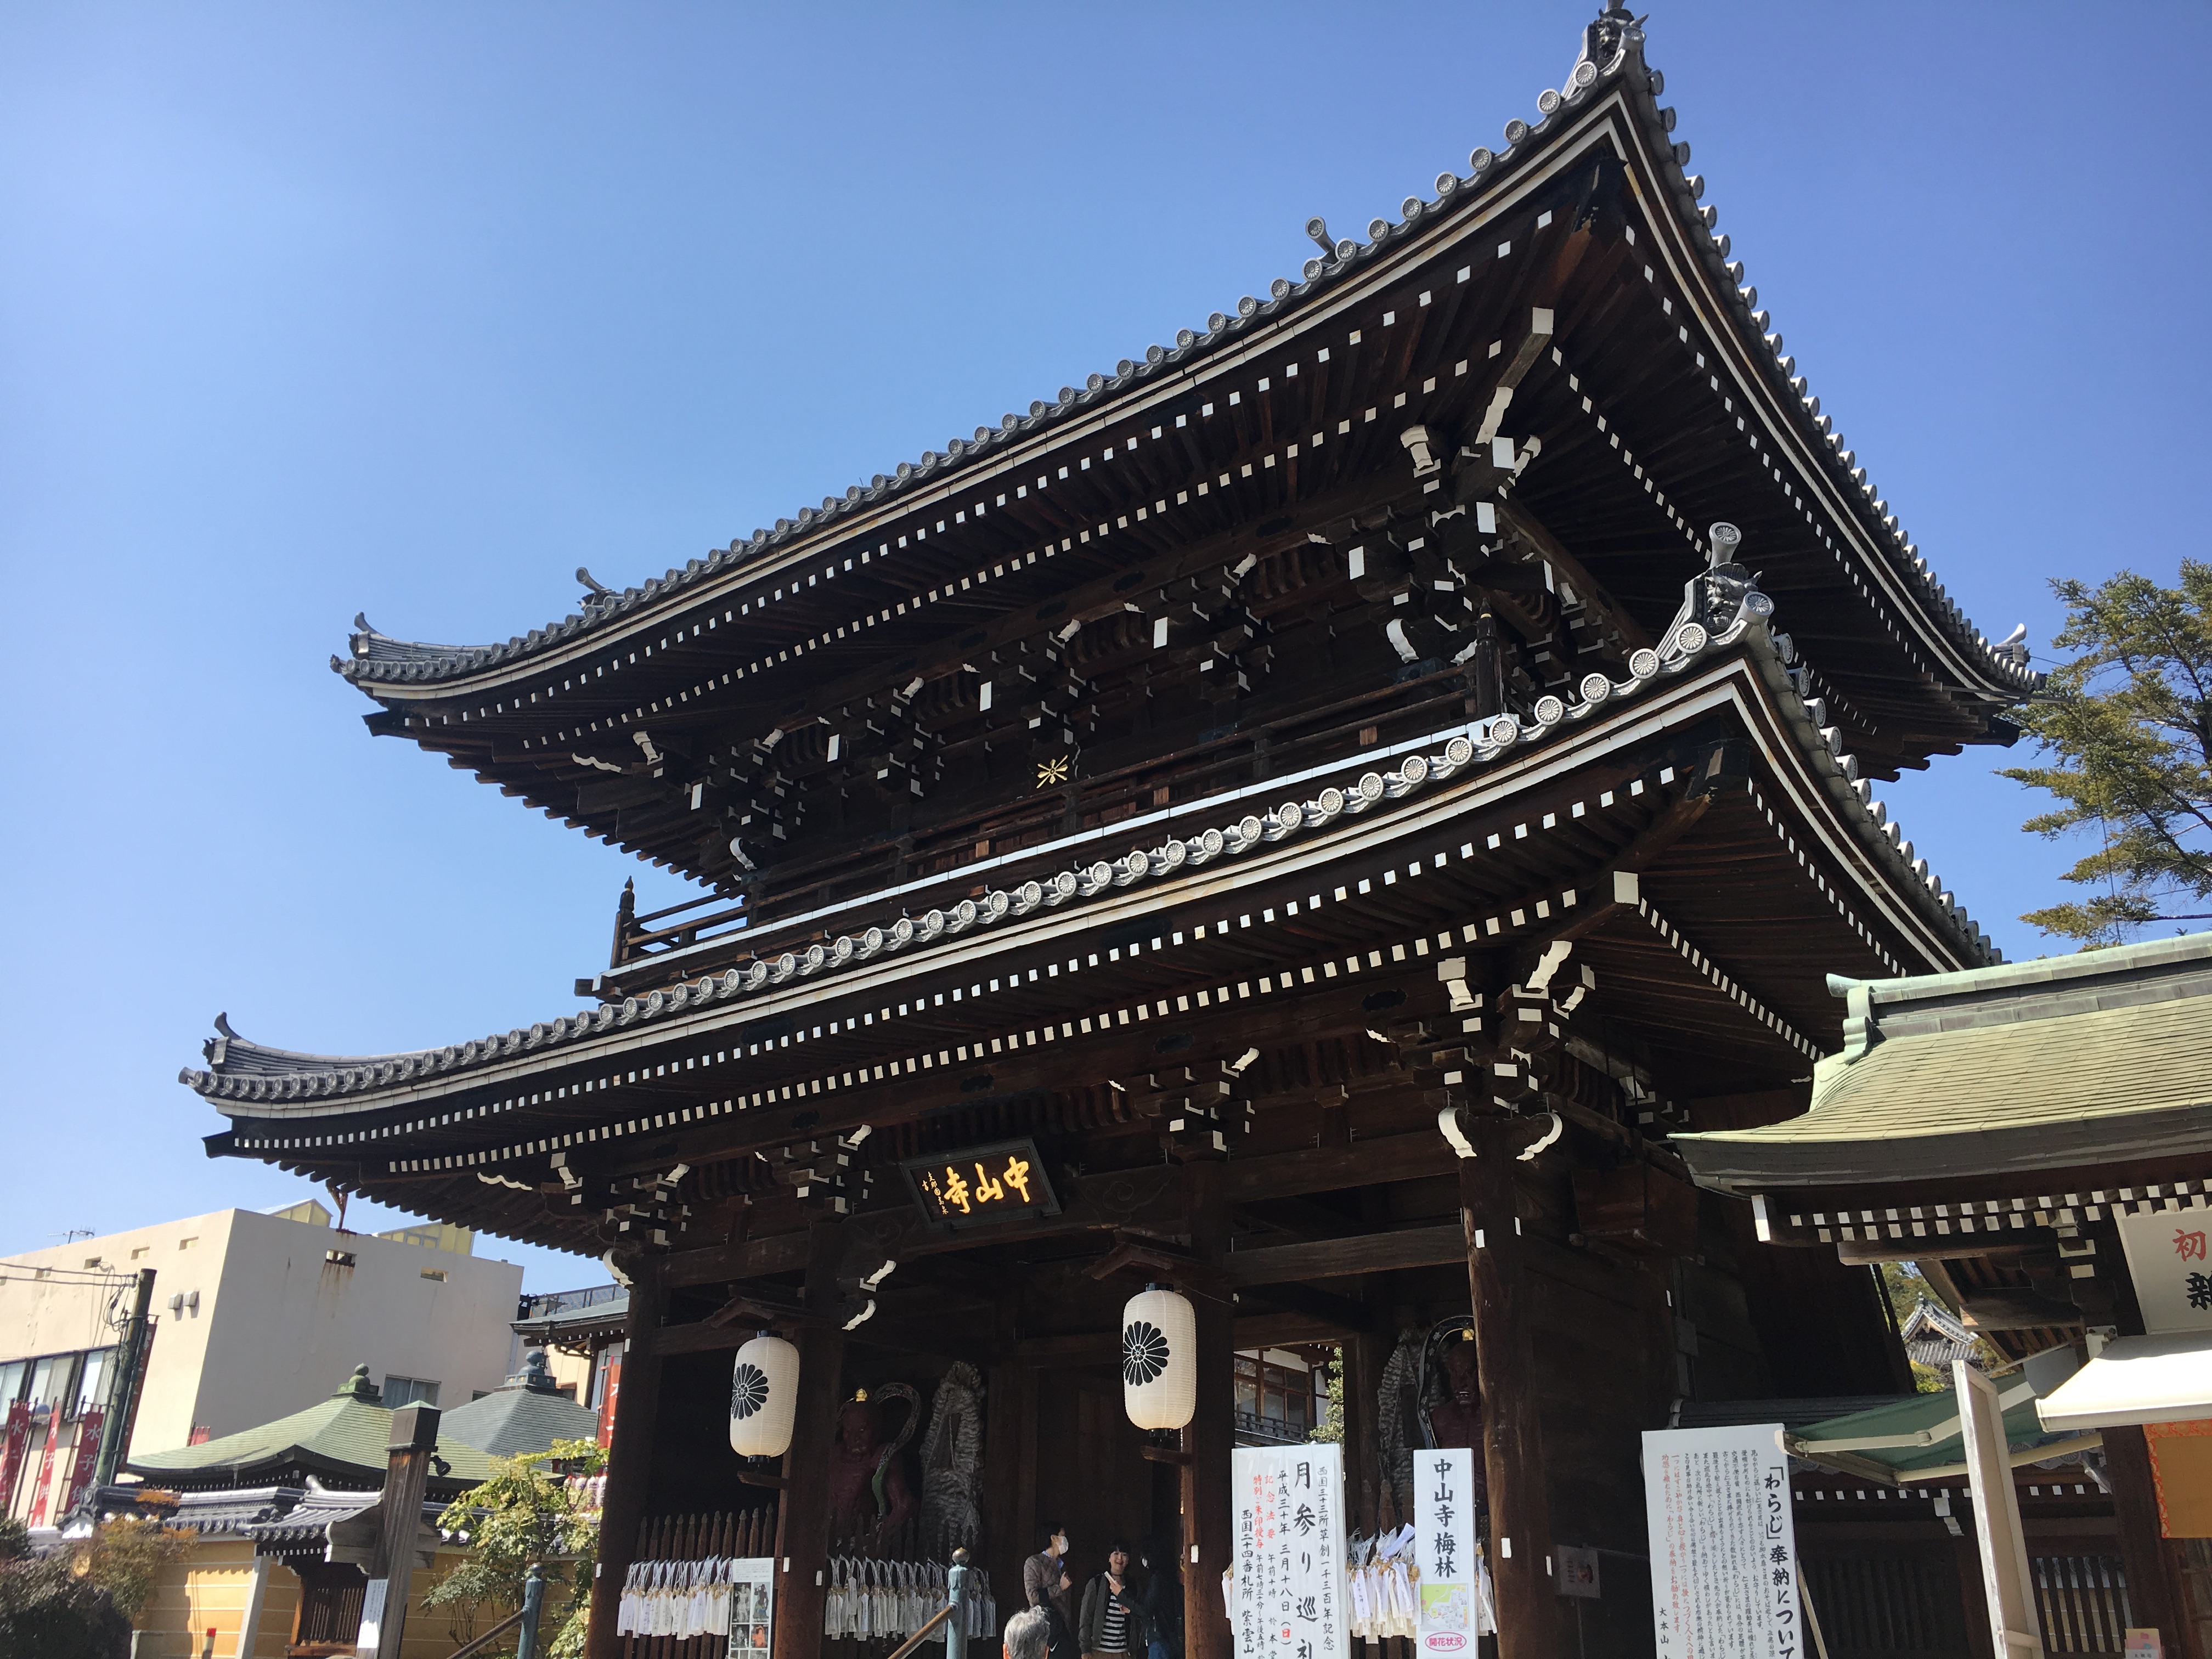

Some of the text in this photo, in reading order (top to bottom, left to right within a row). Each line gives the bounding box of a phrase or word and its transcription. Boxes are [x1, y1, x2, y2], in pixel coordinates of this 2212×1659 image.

[944, 1156, 1030, 1214] 中山寺
[2172, 1229, 2206, 1262] 初
[1254, 1475, 1264, 1549] 特別ご朱印授与
[1265, 1475, 1276, 1539] 記念法要
[1277, 1470, 1291, 1536] 平成三十年
[1240, 1509, 1255, 1654] 西国二十四番札所 紫雲山
[1268, 1554, 1277, 1599] 午前十時
[1294, 1462, 1319, 1659] 月参り巡礼
[1317, 1466, 1335, 1651] 西国三十三所草創一千三百年記念
[1764, 1466, 1795, 1659] 「わらじ」奉納について
[1429, 1637, 1463, 1647] 開花状況
[1659, 1608, 1669, 1644] 大本山
